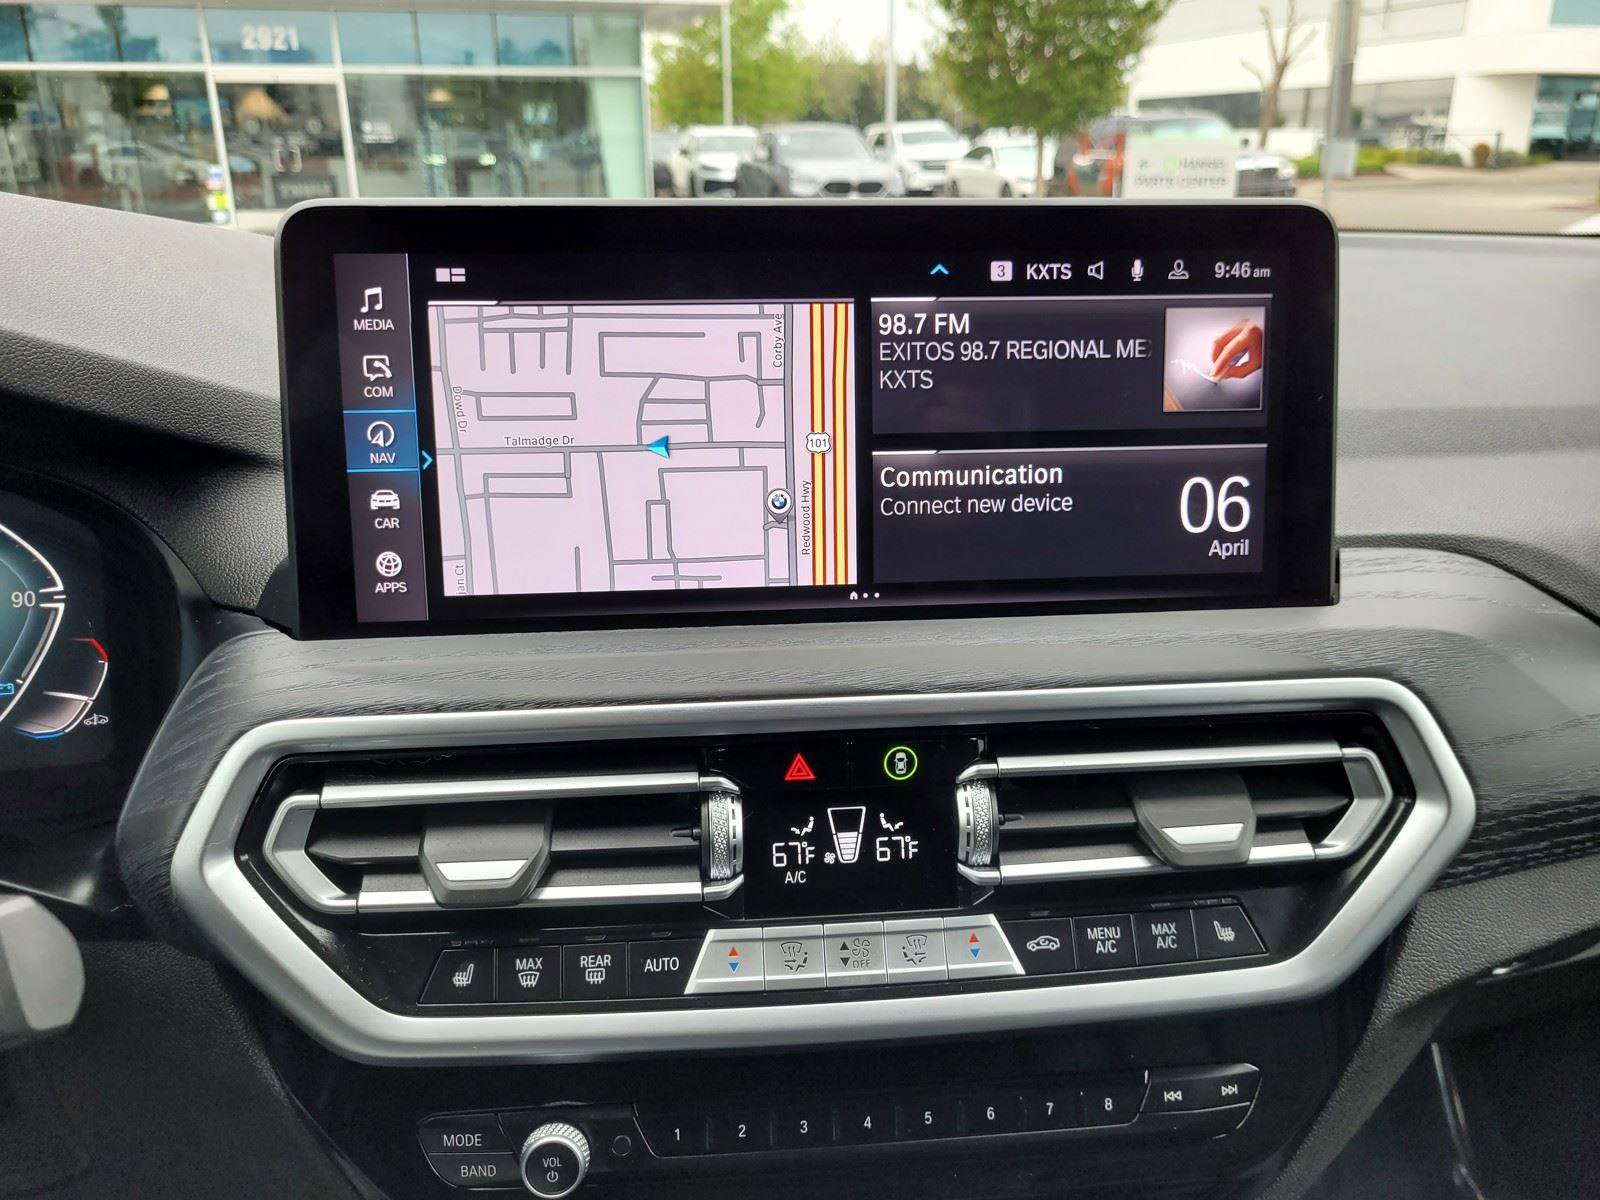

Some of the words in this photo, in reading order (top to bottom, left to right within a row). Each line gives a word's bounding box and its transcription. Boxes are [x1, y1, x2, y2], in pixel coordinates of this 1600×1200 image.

[995, 264, 1007, 279] 3
[1026, 262, 1073, 280] KXTS
[353, 318, 395, 331] MEDIA
[773, 312, 784, 332] Ave
[878, 312, 927, 336] 98.7
[934, 312, 970, 335] FM
[772, 334, 785, 368] Corby
[879, 341, 955, 362] EXITOS
[960, 340, 1001, 362] 98.7
[1006, 339, 1112, 360] REGIONAL
[879, 369, 934, 390] KXTS
[363, 385, 394, 398] COM
[452, 386, 465, 416] Dowd
[457, 419, 467, 433] Dr
[504, 436, 560, 450] Talmadge
[562, 435, 576, 446] Dr
[809, 437, 828, 450] 101
[369, 452, 396, 464] NAV
[880, 463, 1063, 488] Communication
[801, 480, 812, 503] Hwy
[880, 496, 962, 516] Connect
[967, 498, 1006, 514] new
[1011, 493, 1074, 513] device
[1180, 475, 1251, 534] 06
[374, 517, 400, 529] CAR
[801, 506, 812, 555] Redwood
[1208, 538, 1250, 560] April
[454, 564, 465, 576] Ct
[374, 581, 408, 594] APPS
[11, 591, 36, 608] 90
[784, 870, 807, 884] A/C
[1086, 926, 1121, 940] MENU
[1151, 922, 1178, 935] MAX
[1095, 940, 1118, 954] A/C
[1156, 935, 1178, 950] A/C
[515, 957, 544, 970] MAX
[580, 954, 612, 968] REAR
[644, 956, 680, 973] AUTO
[852, 959, 871, 969] OFF
[1045, 1102, 1054, 1116] 7
[1104, 1097, 1113, 1111] 8
[924, 1111, 933, 1125] 5
[986, 1106, 995, 1121] 6
[800, 1120, 808, 1134] 3
[863, 1115, 872, 1129] 4
[674, 1128, 680, 1141] 1
[738, 1124, 747, 1138] 2
[443, 1133, 482, 1147] MODE
[542, 1156, 563, 1168] VOL
[460, 1164, 497, 1178] BAND
